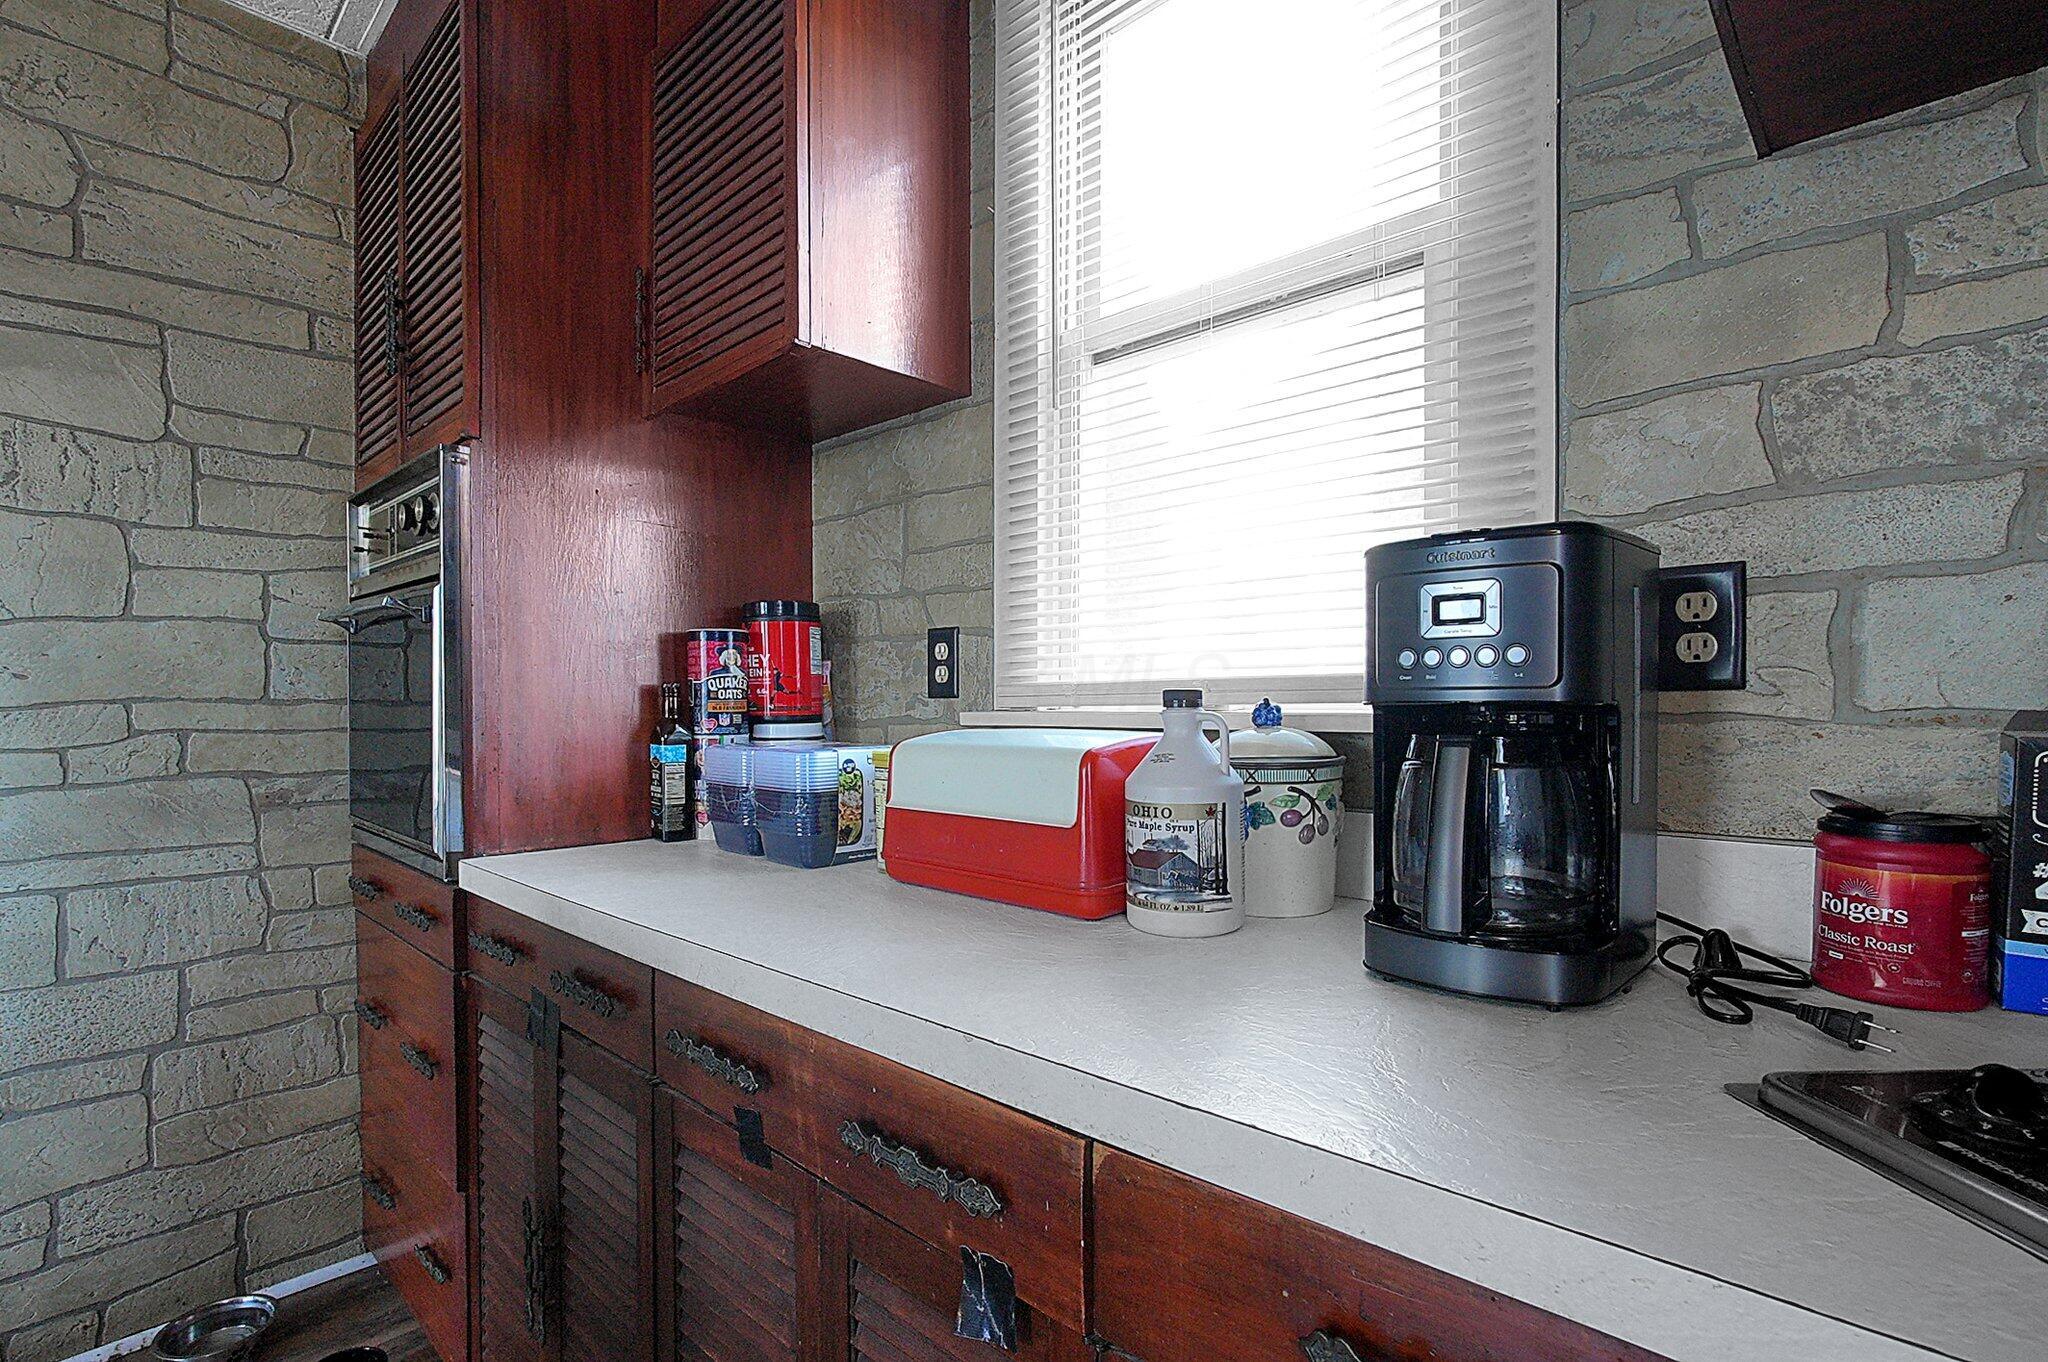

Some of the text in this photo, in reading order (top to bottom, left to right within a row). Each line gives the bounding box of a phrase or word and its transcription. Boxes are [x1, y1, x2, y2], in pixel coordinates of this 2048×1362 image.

[1426, 547, 1495, 564] Cuisinart
[717, 689, 743, 700] OATS
[1133, 804, 1173, 819] OHIO
[1138, 820, 1162, 832] Maple
[1165, 822, 1196, 835] Syrup
[1820, 890, 1909, 925] Folgers
[1818, 924, 1860, 946] Classic
[1864, 935, 1915, 955] Roast
